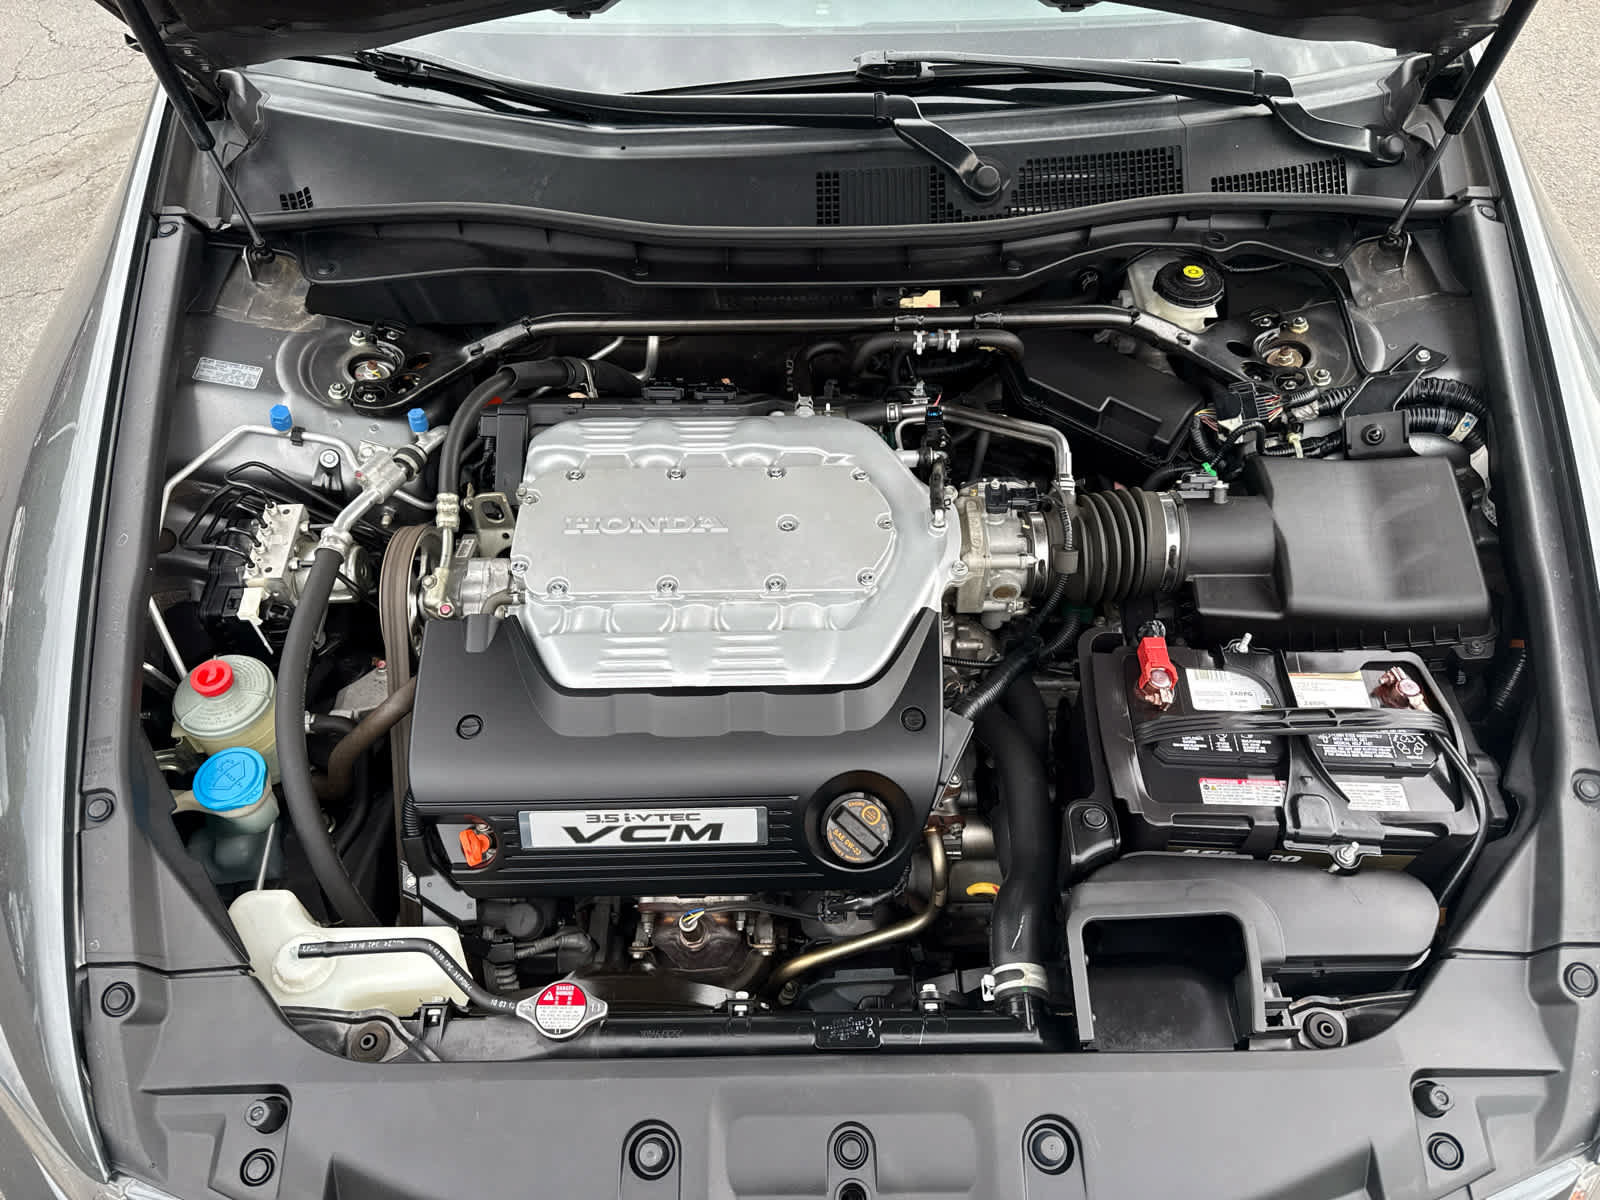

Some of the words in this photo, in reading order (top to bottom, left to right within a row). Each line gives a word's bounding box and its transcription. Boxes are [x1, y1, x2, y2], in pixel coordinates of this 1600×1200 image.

[562, 514, 729, 535] HONDA
[586, 813, 620, 823] 3.5
[624, 812, 701, 822] i-VTEC
[561, 823, 724, 844] VCM
